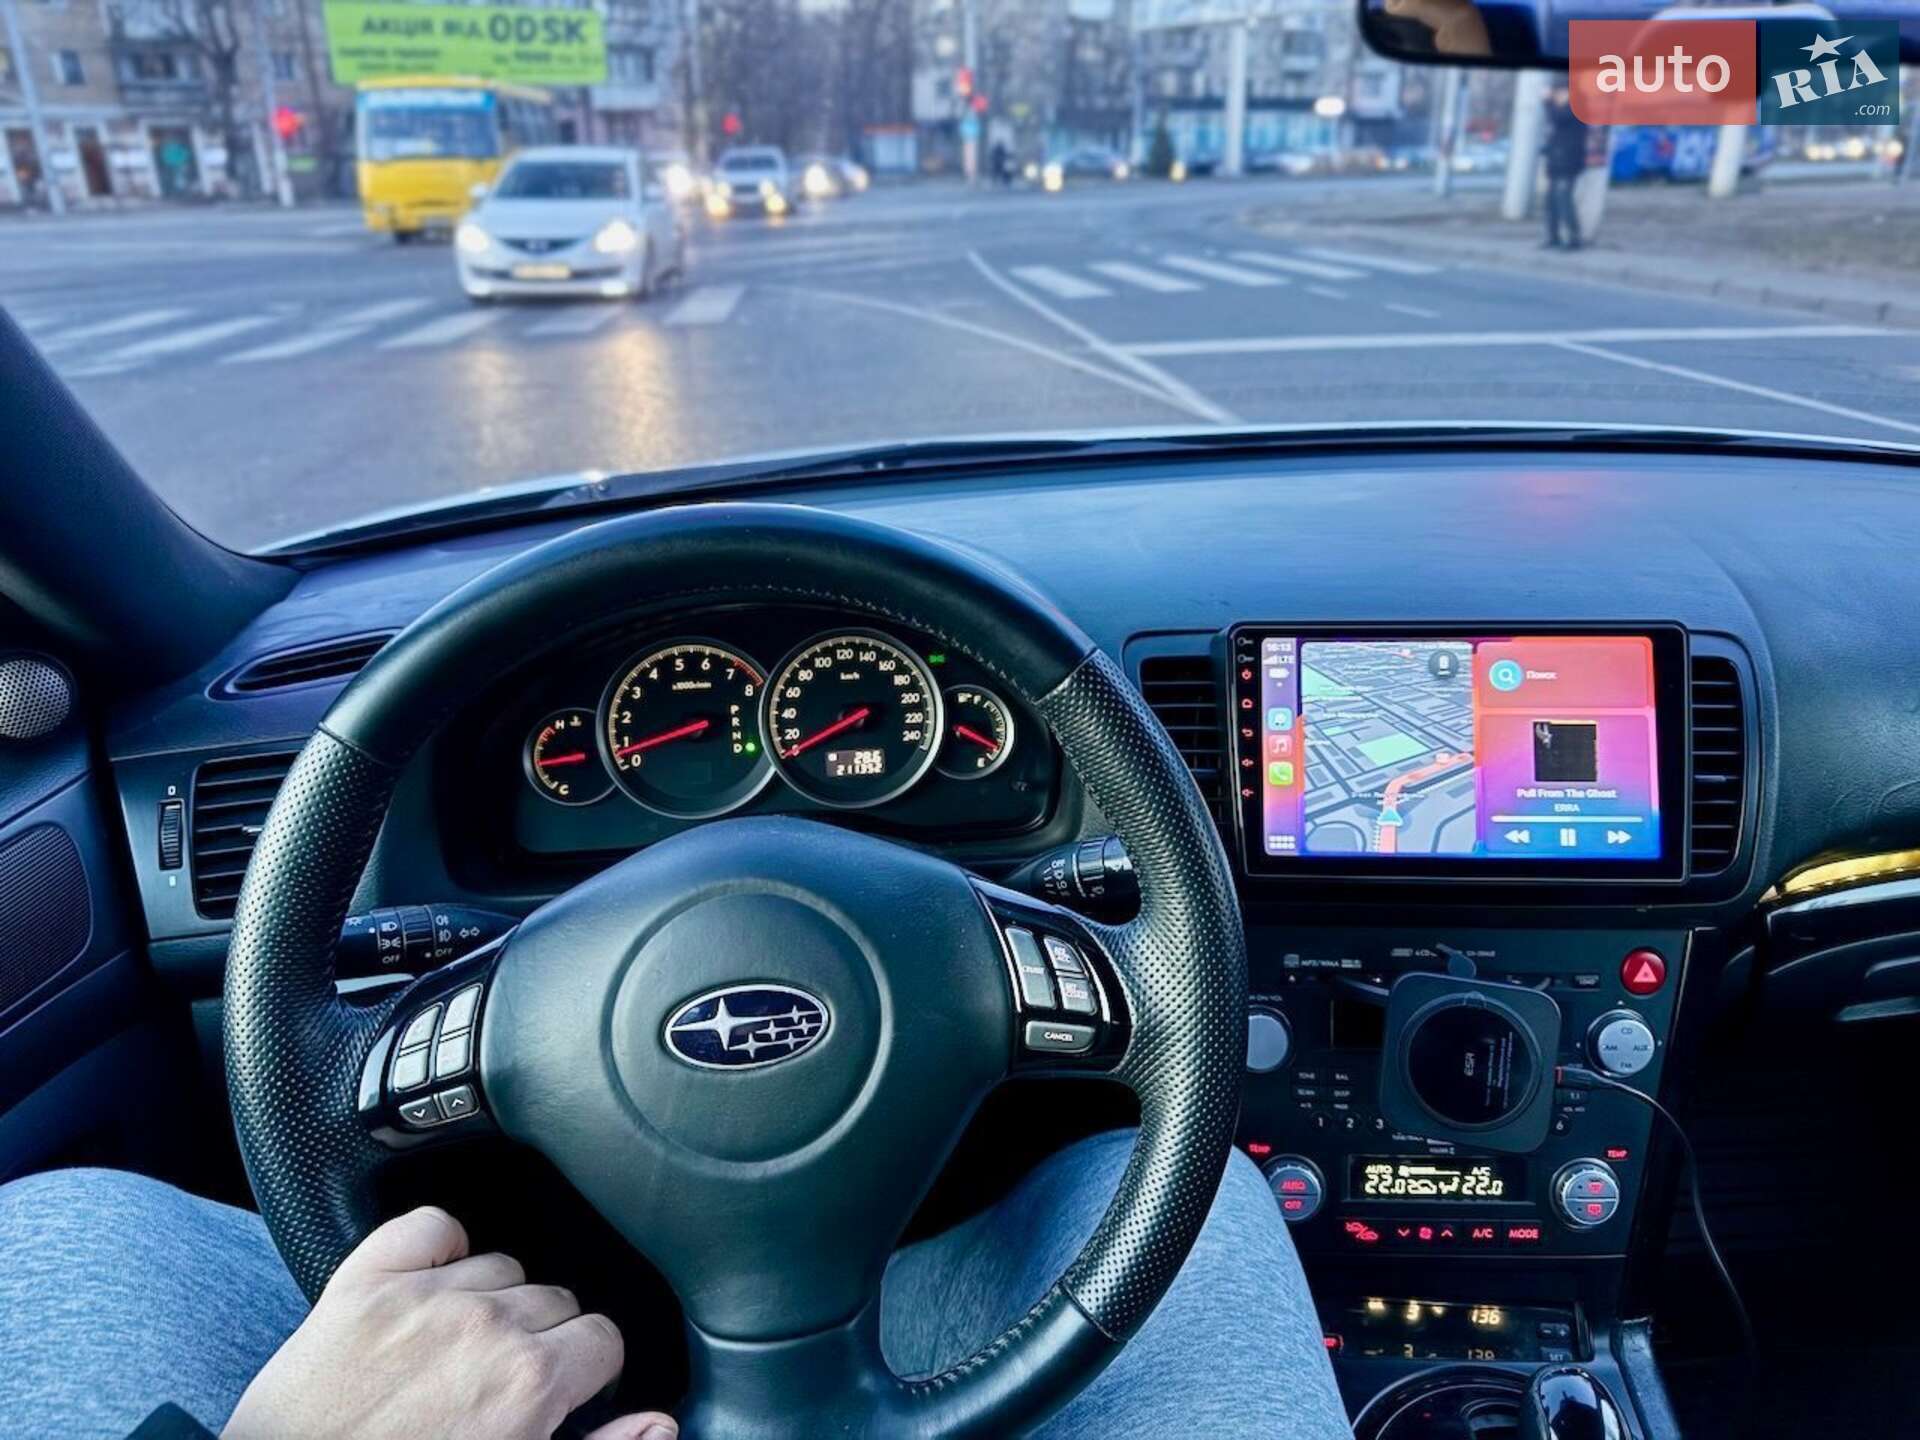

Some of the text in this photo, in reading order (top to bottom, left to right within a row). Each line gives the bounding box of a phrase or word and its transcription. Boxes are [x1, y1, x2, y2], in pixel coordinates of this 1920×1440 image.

[836, 648, 854, 660] 120
[859, 650, 876, 662] 140
[674, 659, 685, 671] 5
[701, 658, 711, 670] 6
[814, 657, 832, 668] 100
[878, 659, 896, 671] 160
[649, 668, 658, 680] 4
[726, 668, 735, 680] 7
[798, 669, 813, 681] 80
[893, 674, 911, 686] 180
[632, 687, 641, 699] 3
[744, 684, 754, 697] 8
[785, 686, 801, 698] 60
[900, 692, 920, 704] 200
[730, 705, 739, 714] P
[781, 707, 797, 719] 40
[621, 712, 632, 723] 2
[731, 717, 740, 727] R
[904, 712, 924, 724] 220
[555, 720, 565, 729] H
[732, 731, 742, 740] N
[784, 728, 800, 740] 20
[902, 729, 921, 742] 240
[623, 736, 629, 747] 1
[733, 743, 743, 753] D
[631, 754, 642, 767] 0
[559, 784, 569, 795] C
[1043, 1031, 1073, 1042] CANCEL
[1620, 1026, 1634, 1035] CD
[1318, 1116, 1324, 1128] 1
[1346, 1117, 1355, 1129] 2
[1375, 1118, 1385, 1130] 3
[1555, 1120, 1565, 1131] 6
[1365, 1164, 1393, 1174] AUTO
[1471, 1166, 1491, 1176] A/C
[1281, 1180, 1306, 1191] AUTO
[1364, 1174, 1406, 1195] 22.0
[1461, 1175, 1504, 1196] 22.0
[1472, 1228, 1494, 1239] A/C
[1508, 1228, 1540, 1240] MODE
